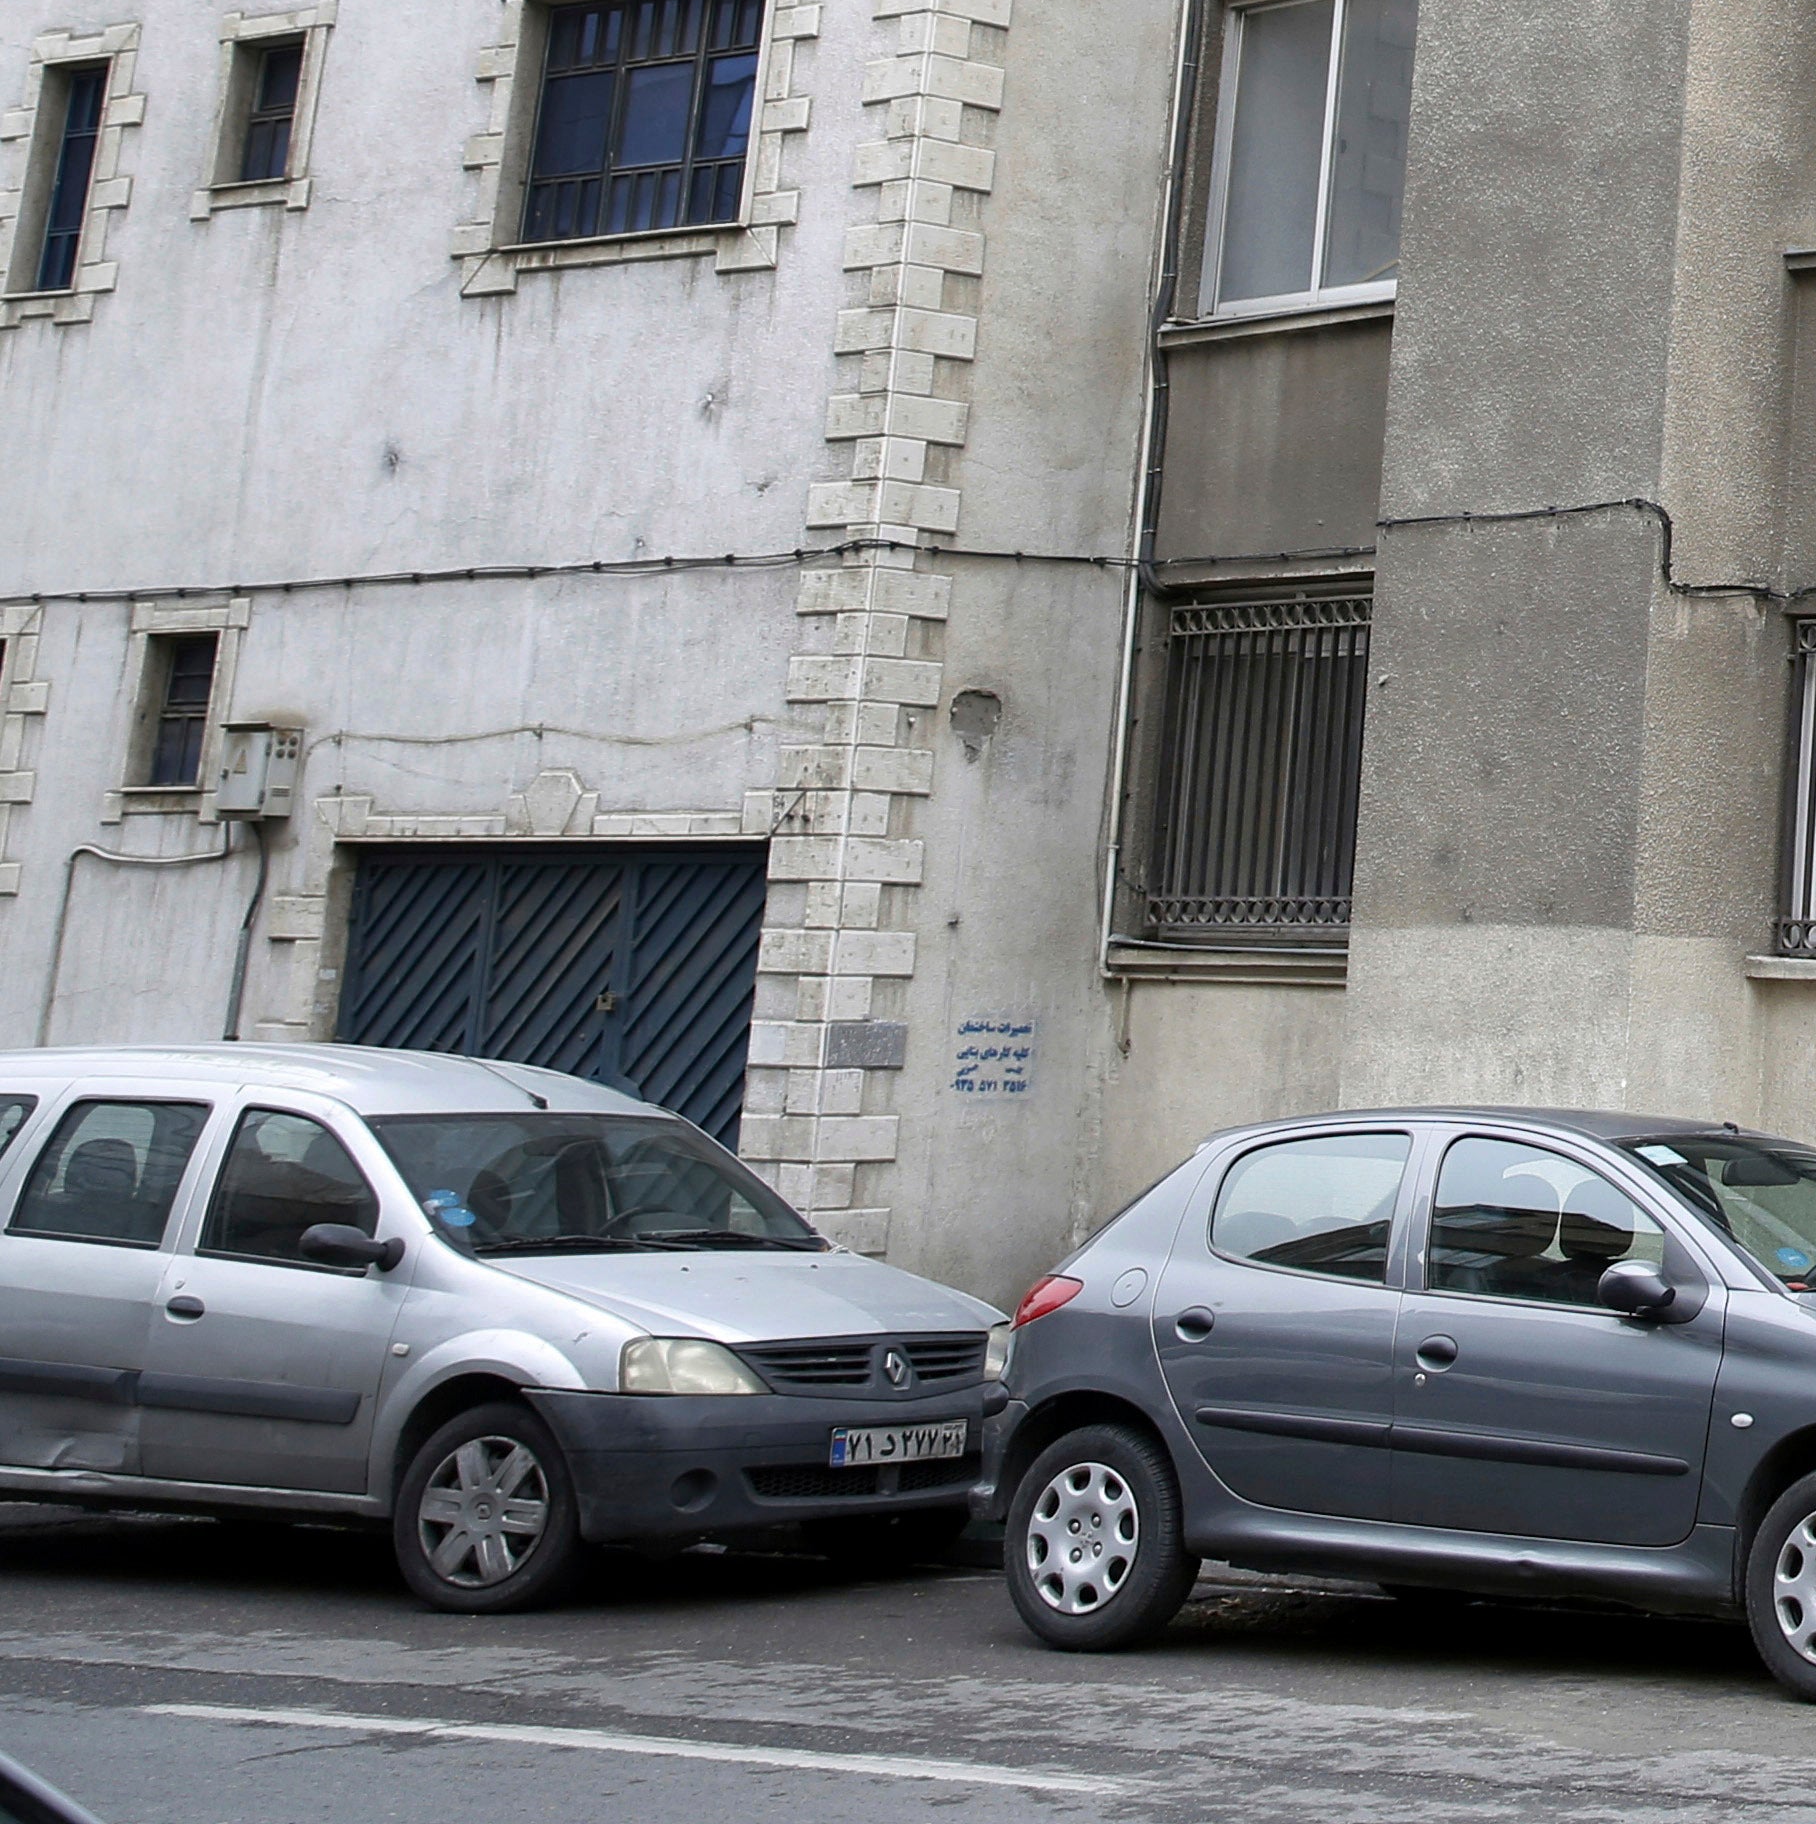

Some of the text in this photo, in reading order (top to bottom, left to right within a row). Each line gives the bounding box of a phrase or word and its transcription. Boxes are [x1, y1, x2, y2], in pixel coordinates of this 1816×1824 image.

[848, 1432, 873, 1462] ۷۱
[879, 1433, 897, 1457] د
[902, 1428, 939, 1457] ۲۷۷
